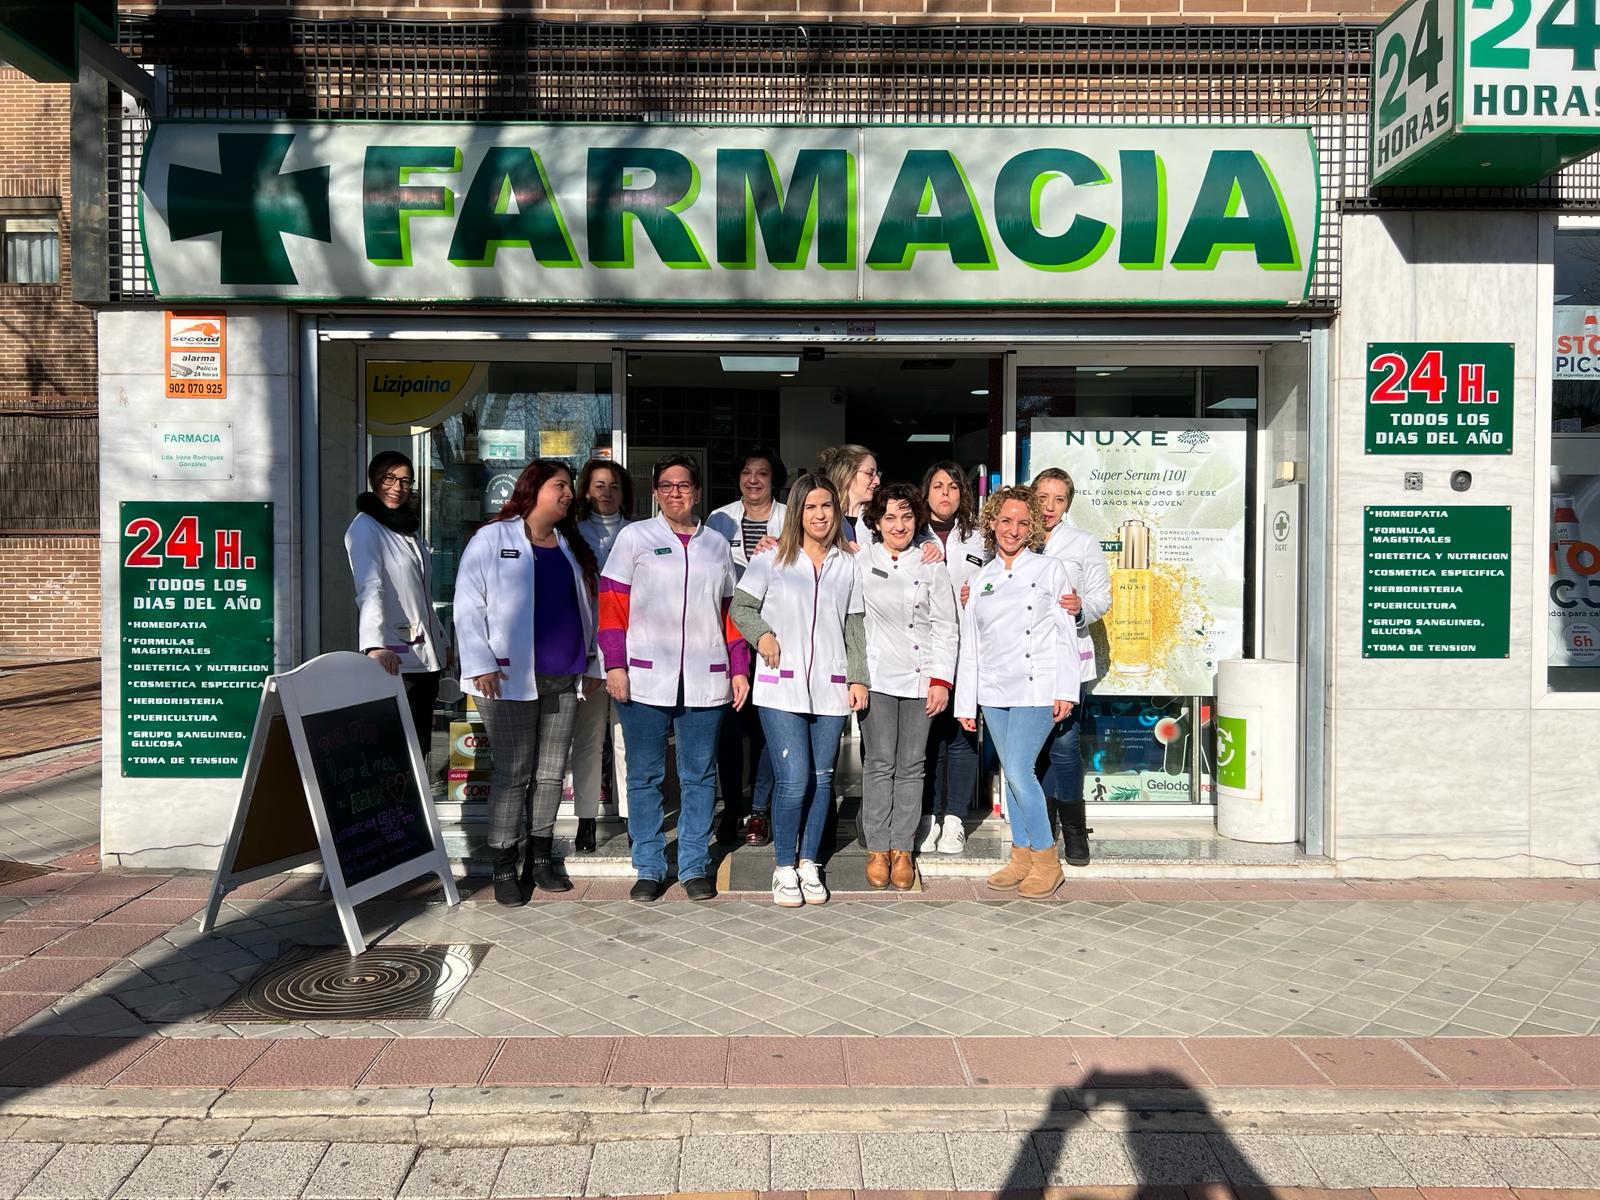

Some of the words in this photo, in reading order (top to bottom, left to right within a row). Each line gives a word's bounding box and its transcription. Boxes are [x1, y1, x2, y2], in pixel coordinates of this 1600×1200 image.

[1470, 0, 1600, 71] 24
[1379, 0, 1443, 132] 24
[1473, 84, 1600, 116] HORA
[1377, 91, 1449, 168] HORAS
[363, 147, 1302, 272] FARMACIA
[182, 354, 216, 362] alarma
[1370, 351, 1447, 404] 24
[1458, 364, 1499, 404] H.
[169, 383, 185, 393] 902
[188, 384, 204, 393] 070
[206, 384, 222, 394] 925
[373, 375, 451, 397] Lizipaina
[1390, 413, 1448, 426] TODOS
[1456, 413, 1489, 426] LOS
[164, 434, 220, 443] FARMACIA
[1066, 430, 1168, 446] NUXE
[1376, 432, 1418, 444] DIAS
[1426, 432, 1458, 444] DEL
[1466, 429, 1503, 444] AÑO
[1090, 469, 1122, 482] Super
[1125, 469, 1160, 481] Serum
[1163, 469, 1187, 482] [10]
[1374, 510, 1449, 518] HOMEOPATIA
[125, 516, 203, 569] 24
[215, 530, 256, 569] H.
[147, 578, 205, 591] TODOS
[214, 579, 247, 591] LOS
[133, 597, 175, 610] DIAS
[184, 597, 216, 610] DEL
[224, 595, 262, 610] AÑO
[1569, 611, 1587, 619] para
[133, 621, 207, 629] HOMEOPATIA
[1573, 635, 1593, 647] 6h
[131, 647, 211, 655] MAGISTRALES
[207, 664, 269, 672] NUTRICION
[133, 714, 218, 722] PUERICULTURA
[464, 736, 490, 748] COR
[464, 785, 491, 796] COR
